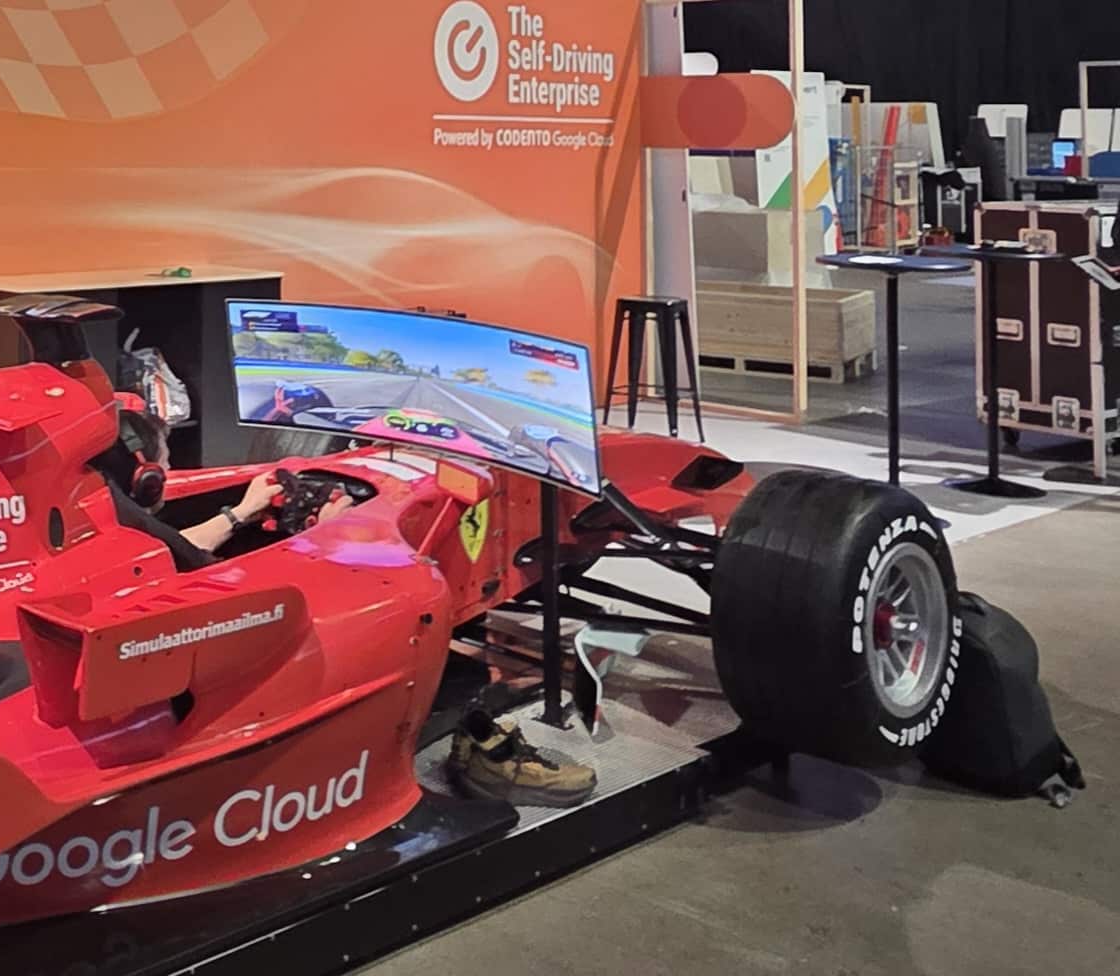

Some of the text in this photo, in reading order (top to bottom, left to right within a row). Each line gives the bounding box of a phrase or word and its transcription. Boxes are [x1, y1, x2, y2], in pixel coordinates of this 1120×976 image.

[508, 6, 543, 37] The
[508, 40, 613, 81] Self-Driving
[508, 74, 599, 112] Enterprise
[434, 128, 479, 146] Powered
[481, 128, 493, 150] by
[496, 129, 551, 146] CODENTO
[552, 130, 586, 151] Google
[852, 515, 917, 654] POTENZA
[119, 603, 284, 660] Simulaattorimaailma.fi
[213, 749, 369, 847] Cloud
